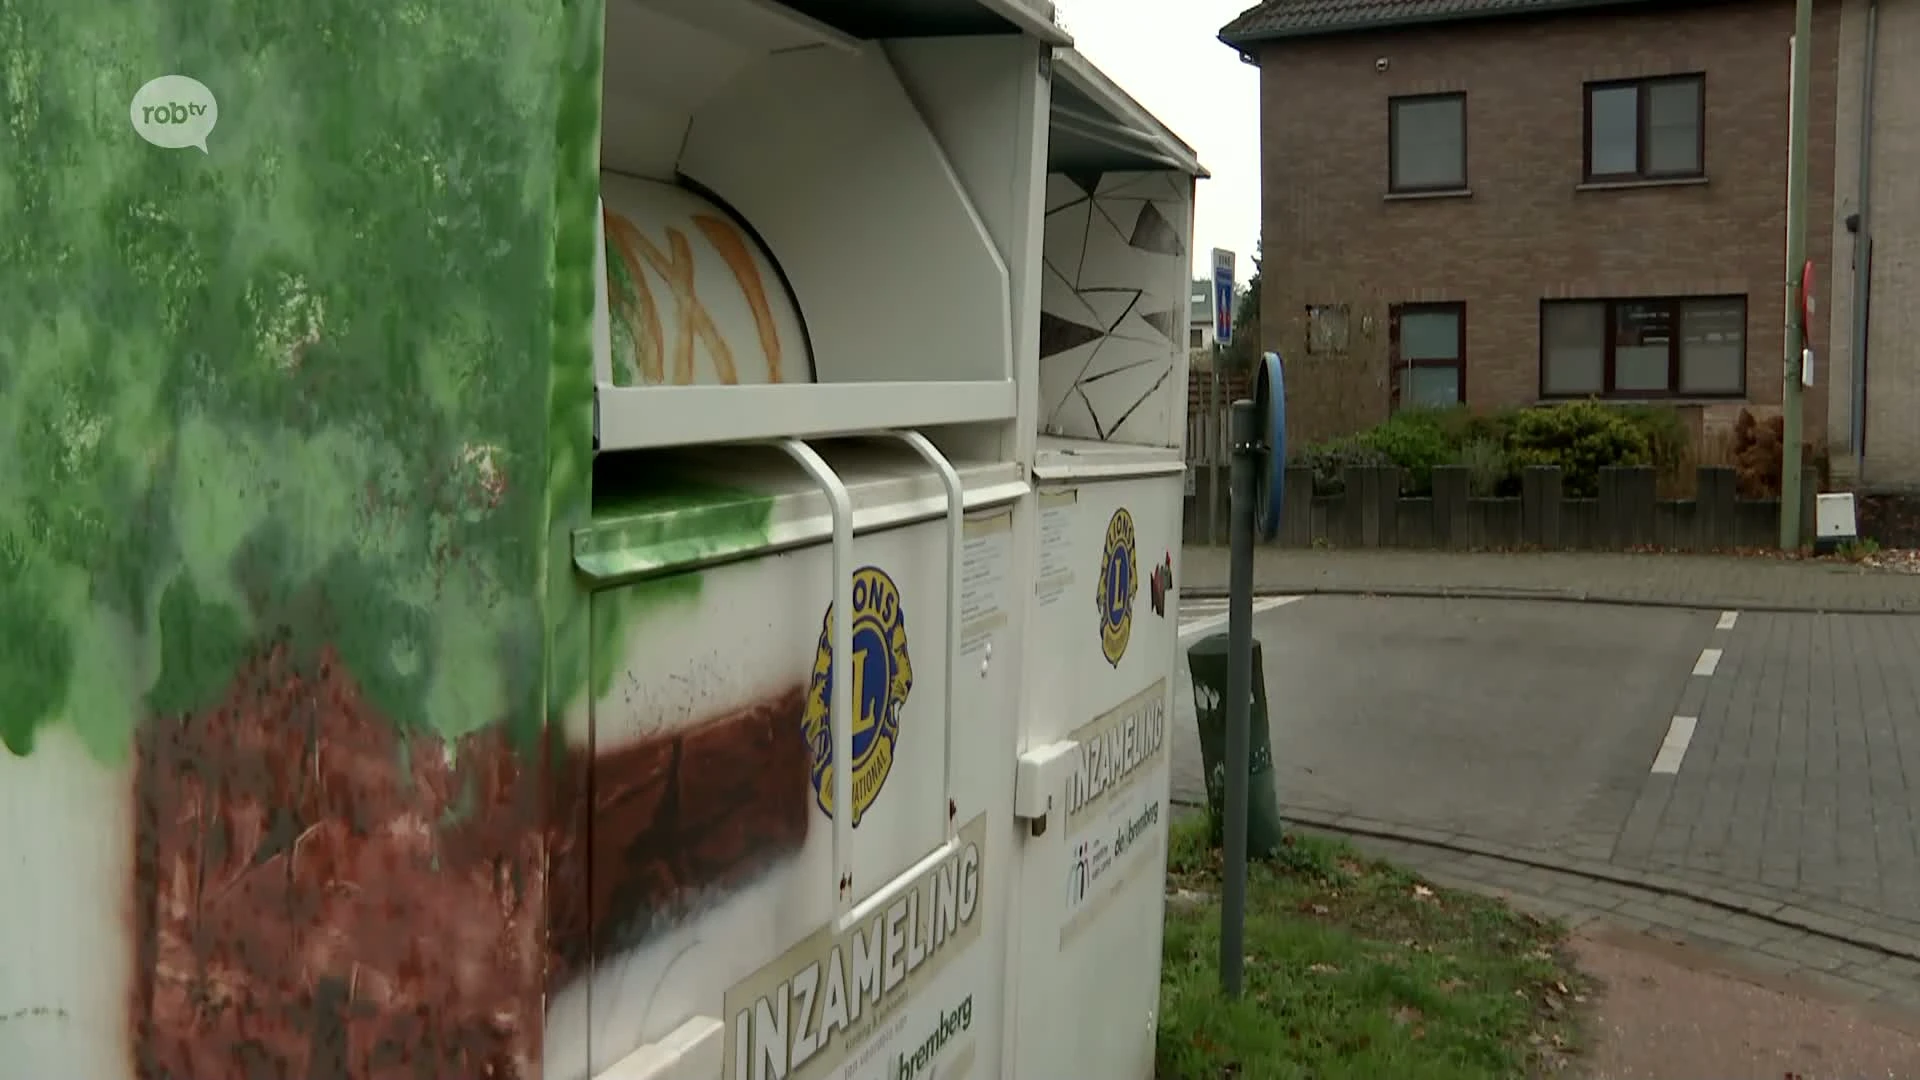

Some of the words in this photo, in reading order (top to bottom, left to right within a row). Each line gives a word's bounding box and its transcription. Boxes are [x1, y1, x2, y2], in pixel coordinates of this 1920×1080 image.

[1109, 515, 1133, 545] LIONS
[1113, 558, 1124, 612] L
[1068, 701, 1163, 816] INZAMELING
[734, 842, 979, 1080] INZAMELING
